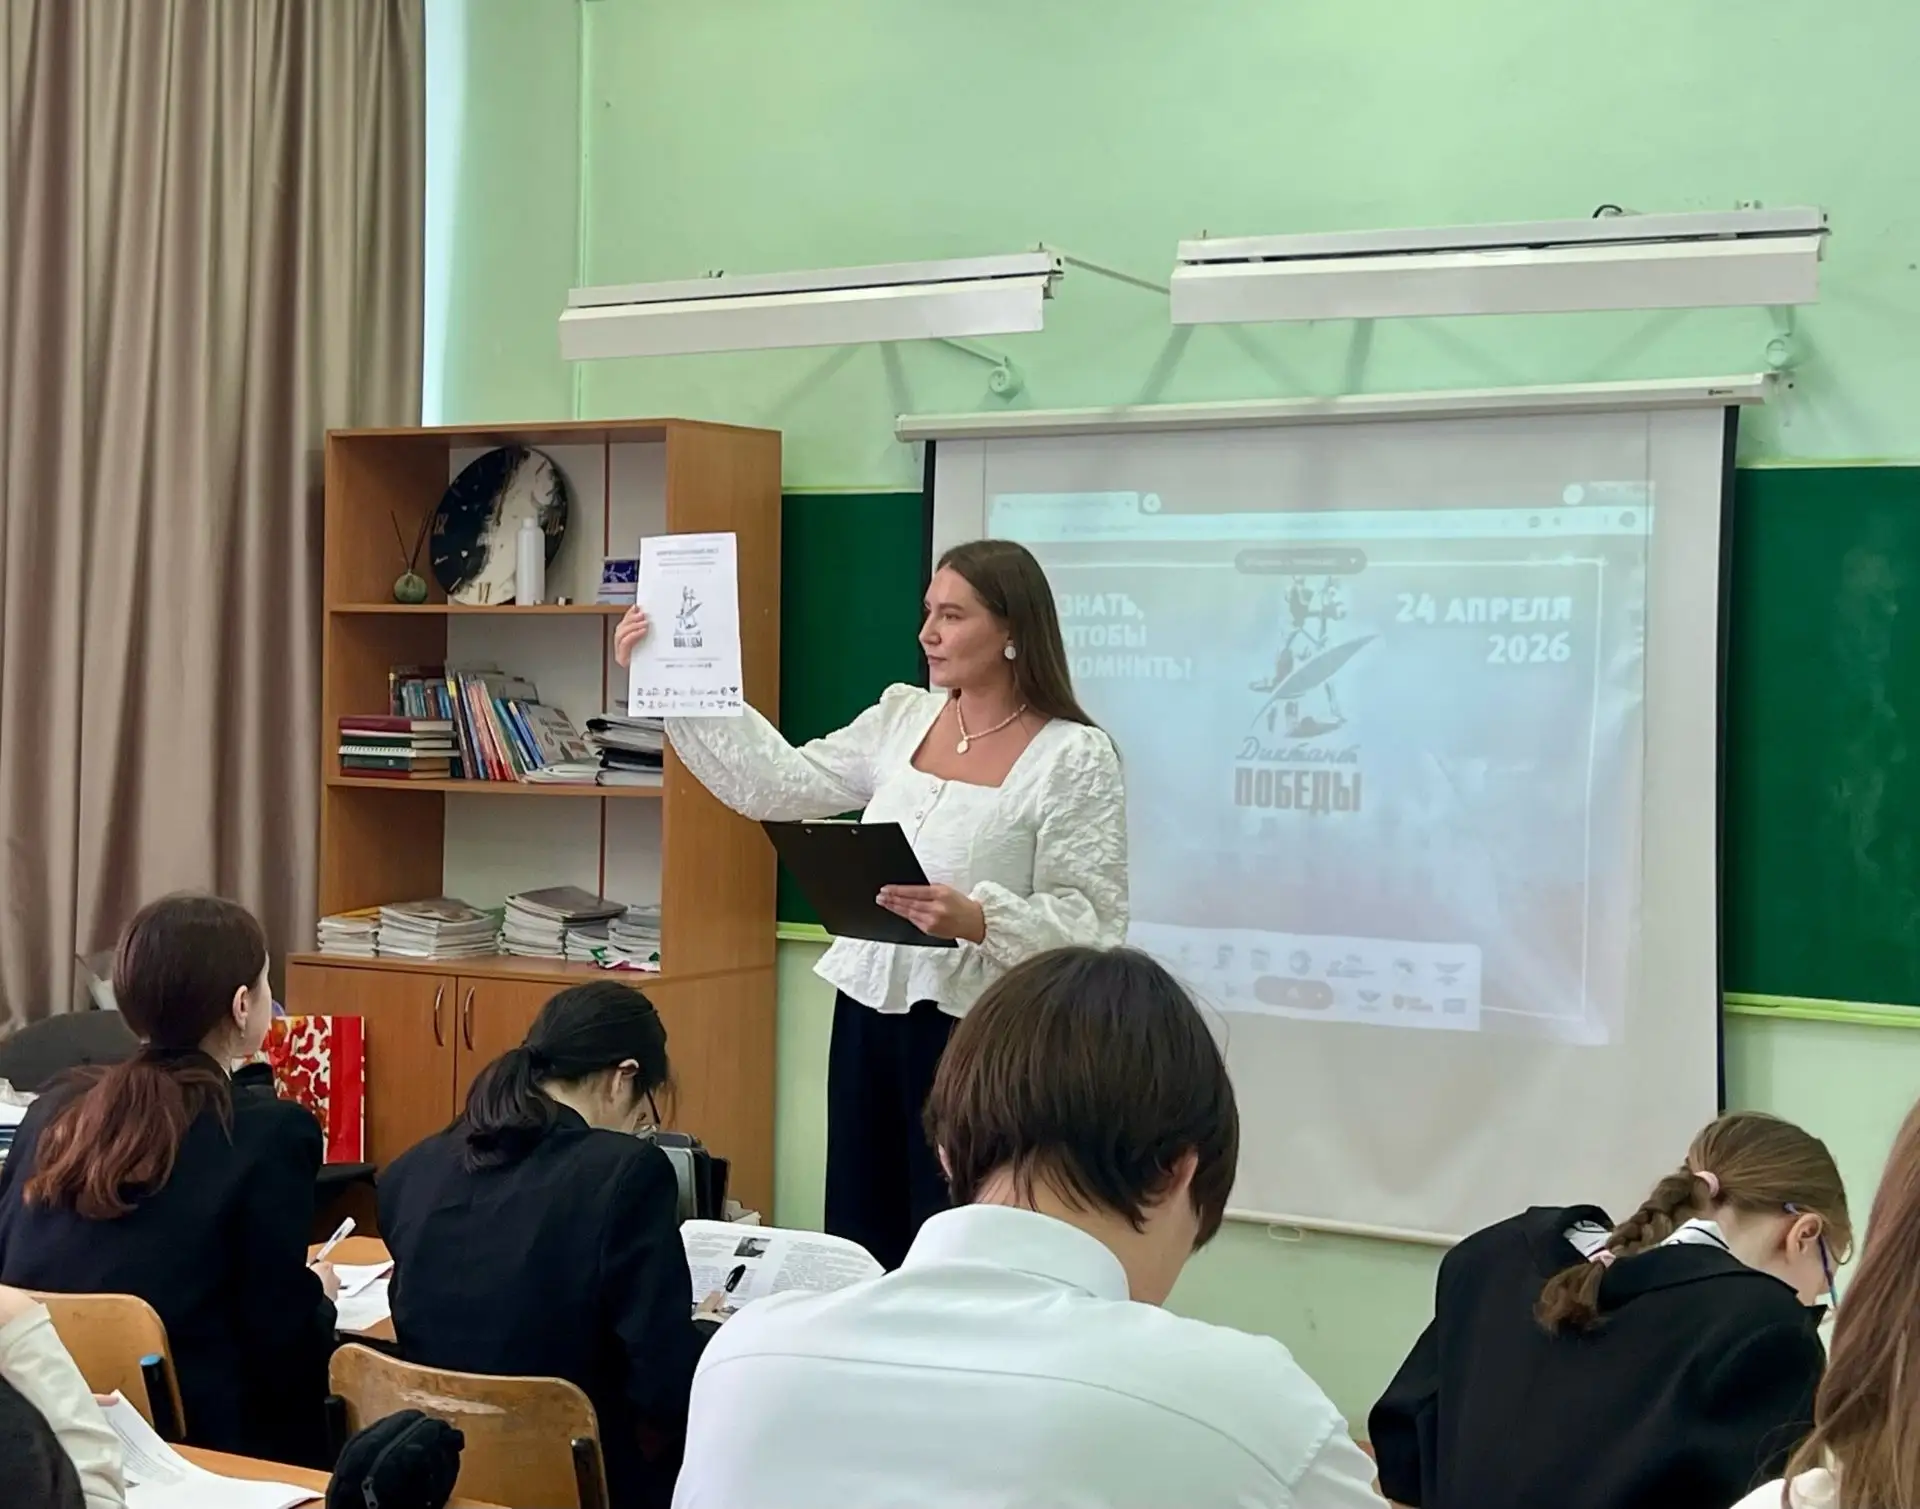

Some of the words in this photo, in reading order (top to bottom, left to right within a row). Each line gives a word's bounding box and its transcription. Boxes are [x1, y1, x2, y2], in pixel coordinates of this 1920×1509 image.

[1396, 593, 1436, 624] 24
[1444, 596, 1572, 622] АПРЕЛЯ
[1486, 632, 1570, 663] 2026
[1235, 736, 1361, 763] Диктант
[1234, 767, 1362, 816] ПОБЕДЫ
